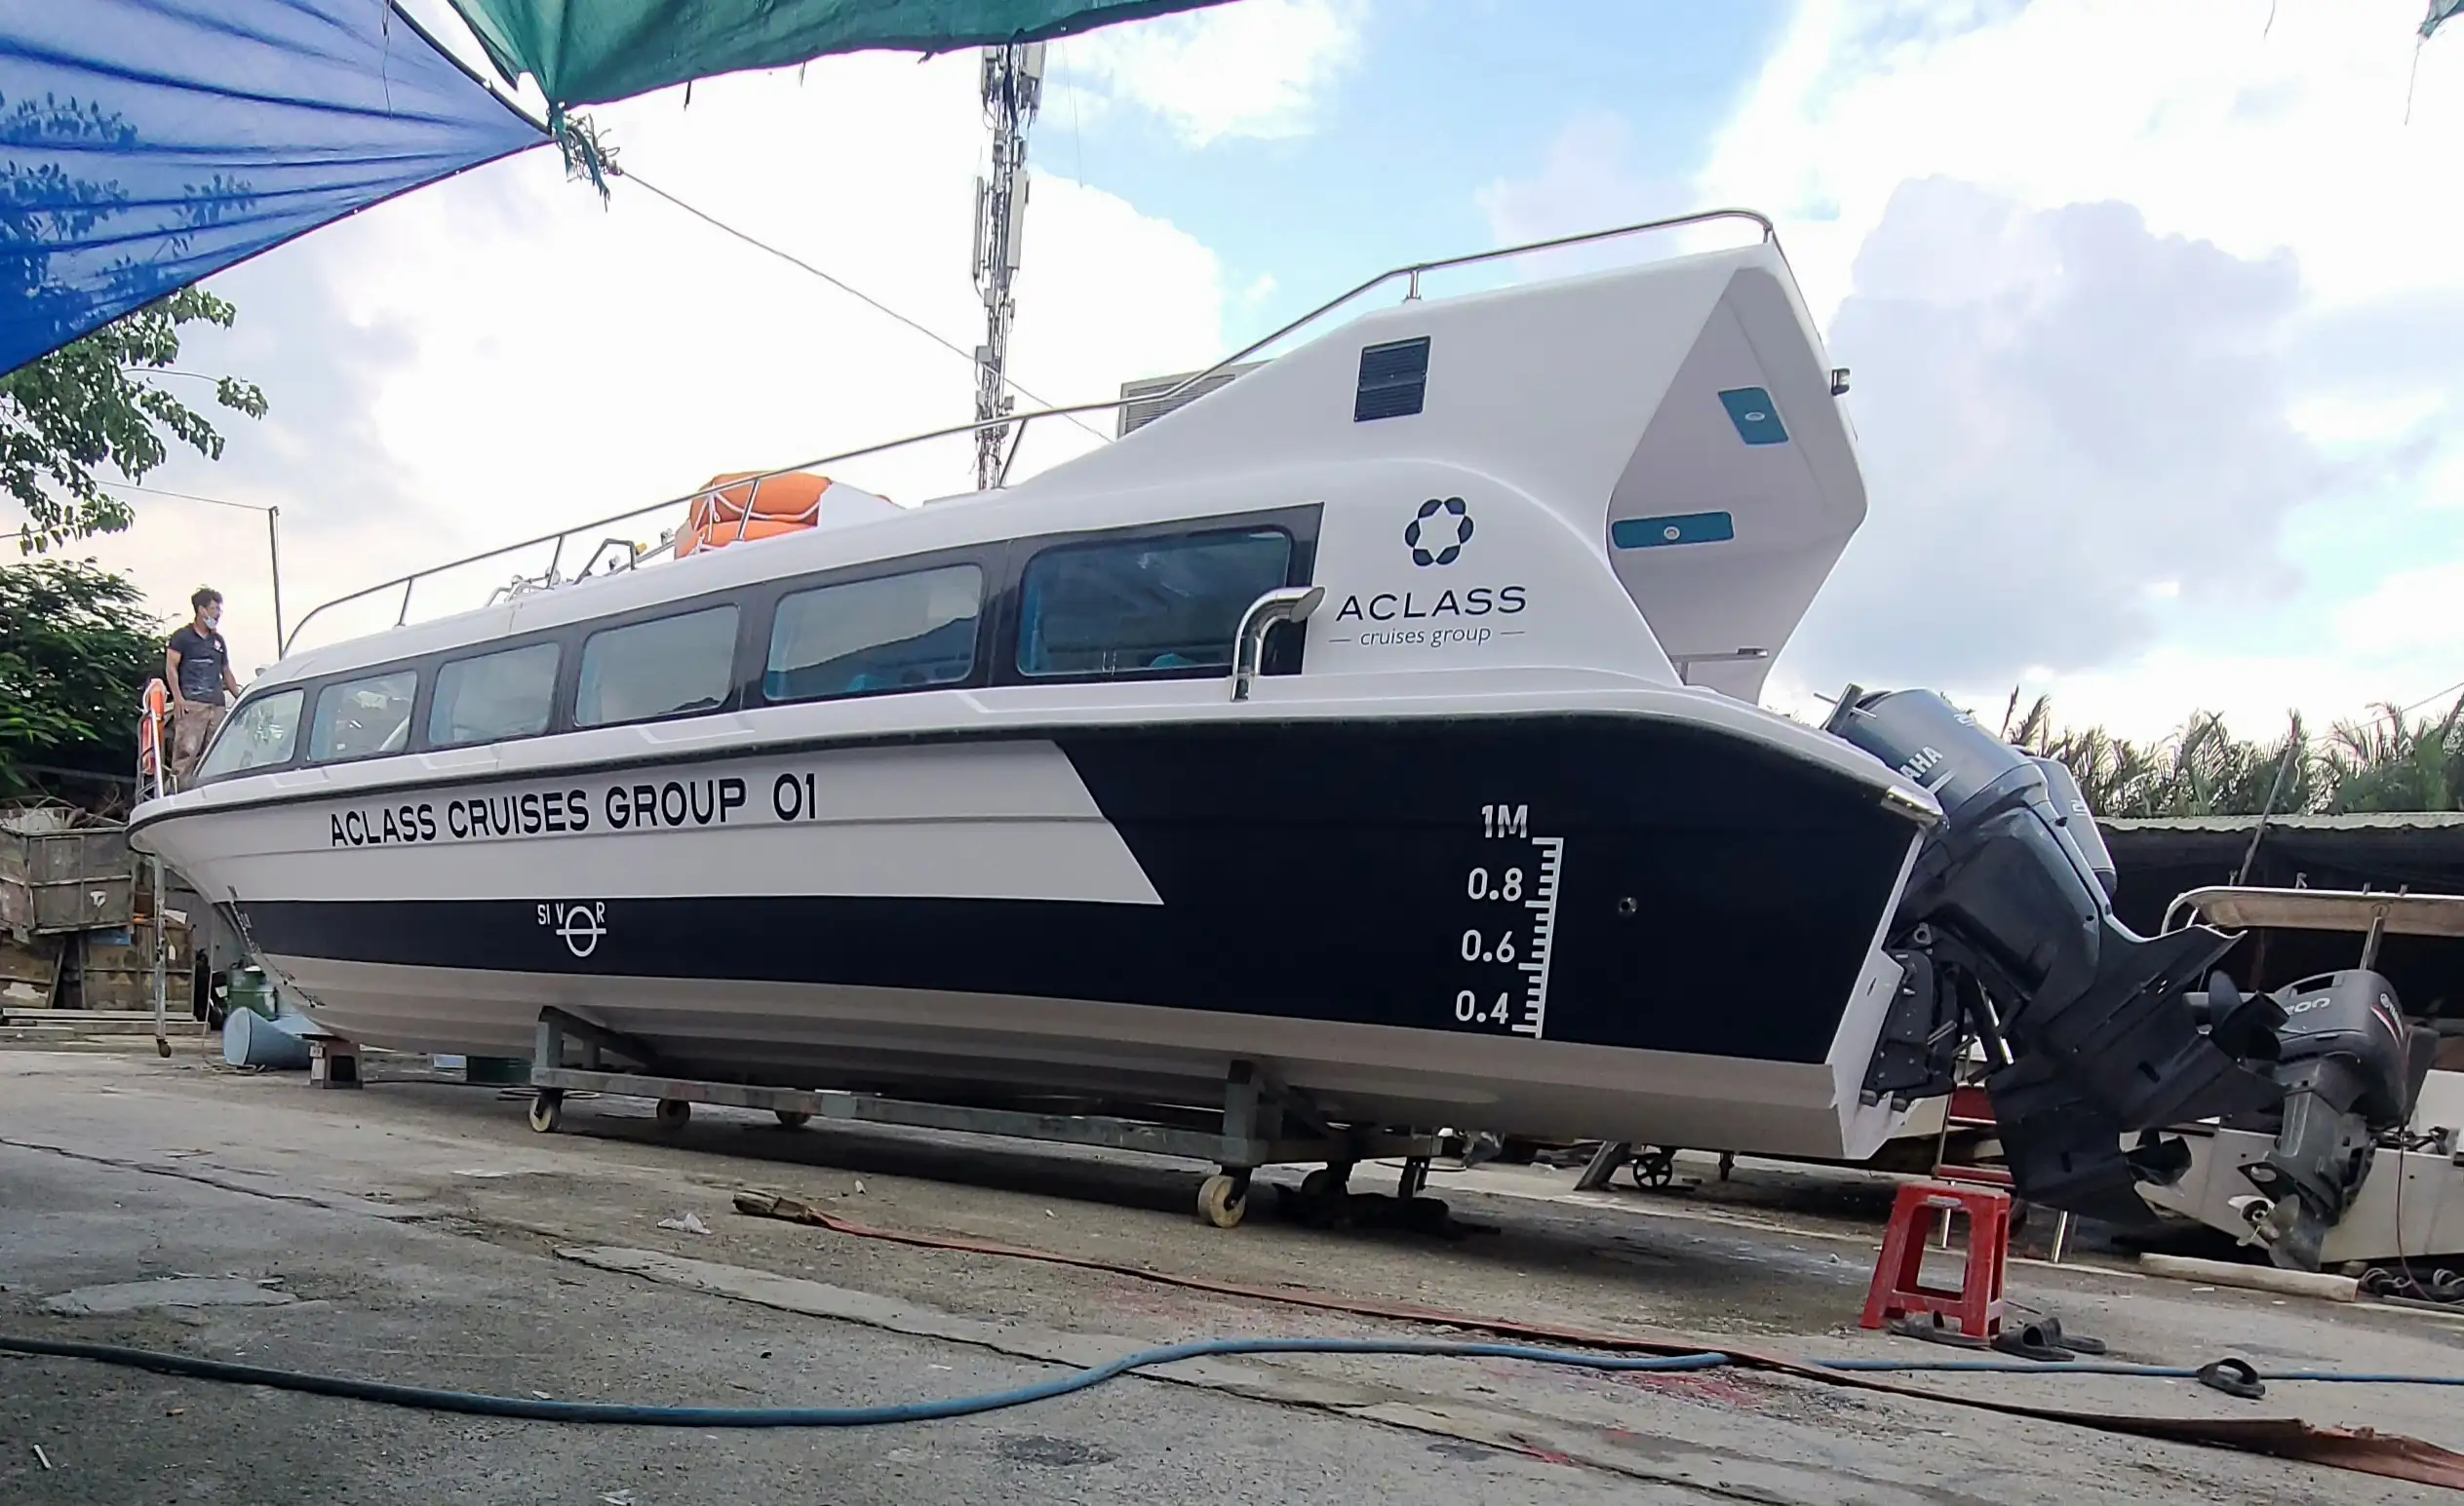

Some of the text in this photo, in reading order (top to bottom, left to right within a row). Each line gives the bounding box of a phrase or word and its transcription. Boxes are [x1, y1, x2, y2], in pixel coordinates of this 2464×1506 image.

[1335, 585, 1527, 622] ACLASS
[1360, 627, 1492, 648] cruises group
[1899, 746, 1943, 779] AHA
[330, 772, 817, 847] ACLASS CRUISES GROUP 01
[1481, 804, 1529, 838] 1M
[1467, 867, 1523, 902] 0.8
[1461, 929, 1516, 963] 0.6
[1455, 989, 1509, 1024] 0.4
